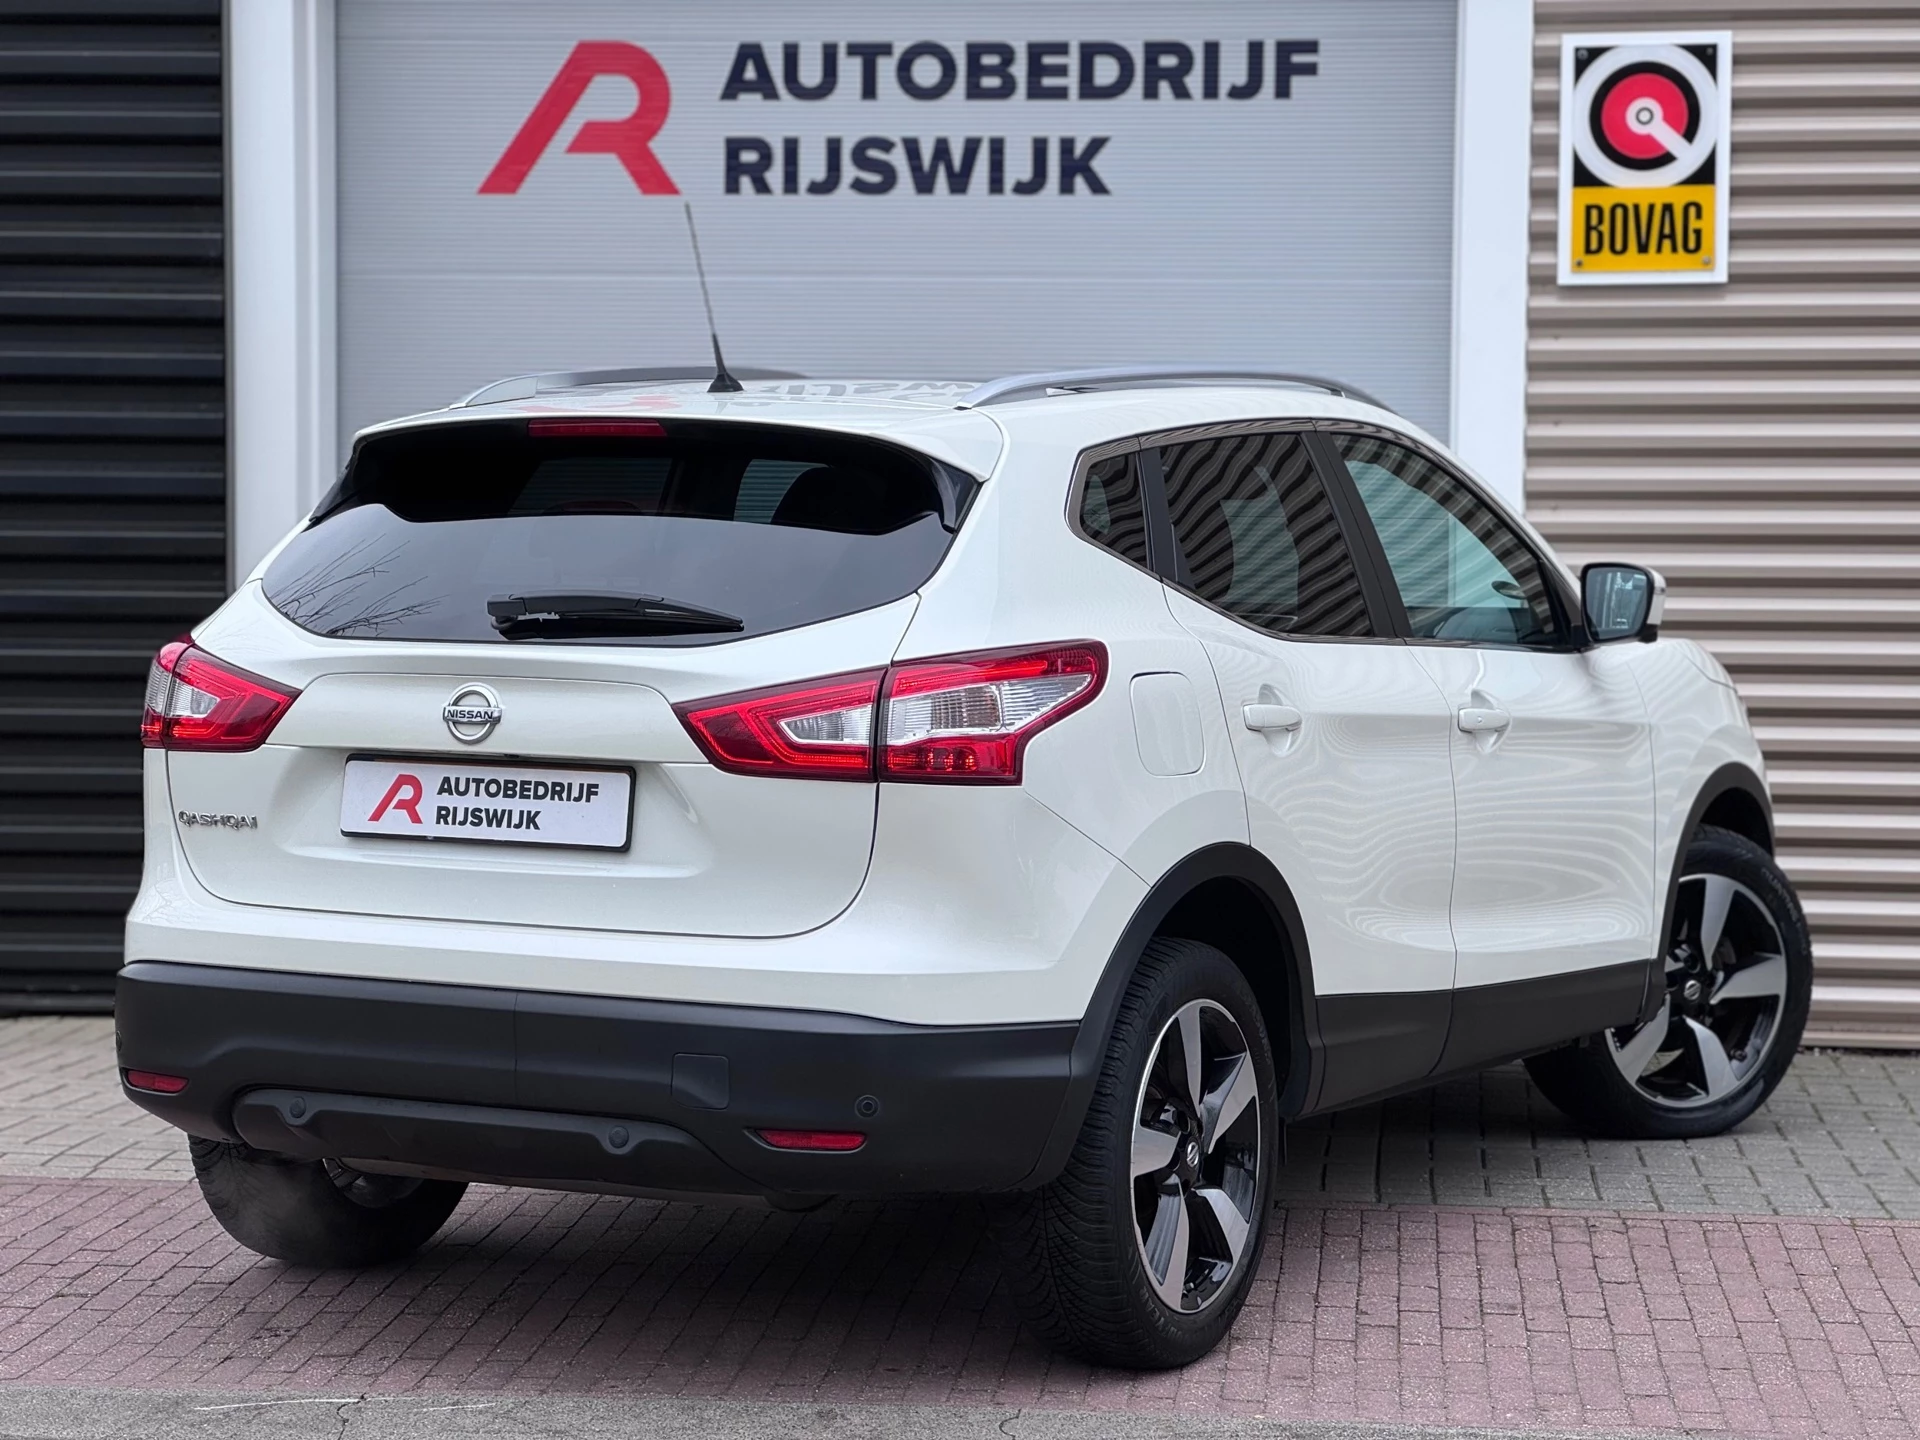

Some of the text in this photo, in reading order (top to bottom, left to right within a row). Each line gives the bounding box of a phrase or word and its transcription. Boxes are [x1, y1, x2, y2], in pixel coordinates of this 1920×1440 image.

[720, 40, 1320, 101] AUTOBEDRIJF
[724, 136, 1112, 196] RIJSWIJK
[1584, 201, 1703, 256] BOVAG
[447, 709, 494, 720] NISSAN
[436, 776, 600, 803] AUTOBEDRIJF
[178, 810, 259, 831] QASHQAI
[435, 805, 542, 831] RIJSWIJK
